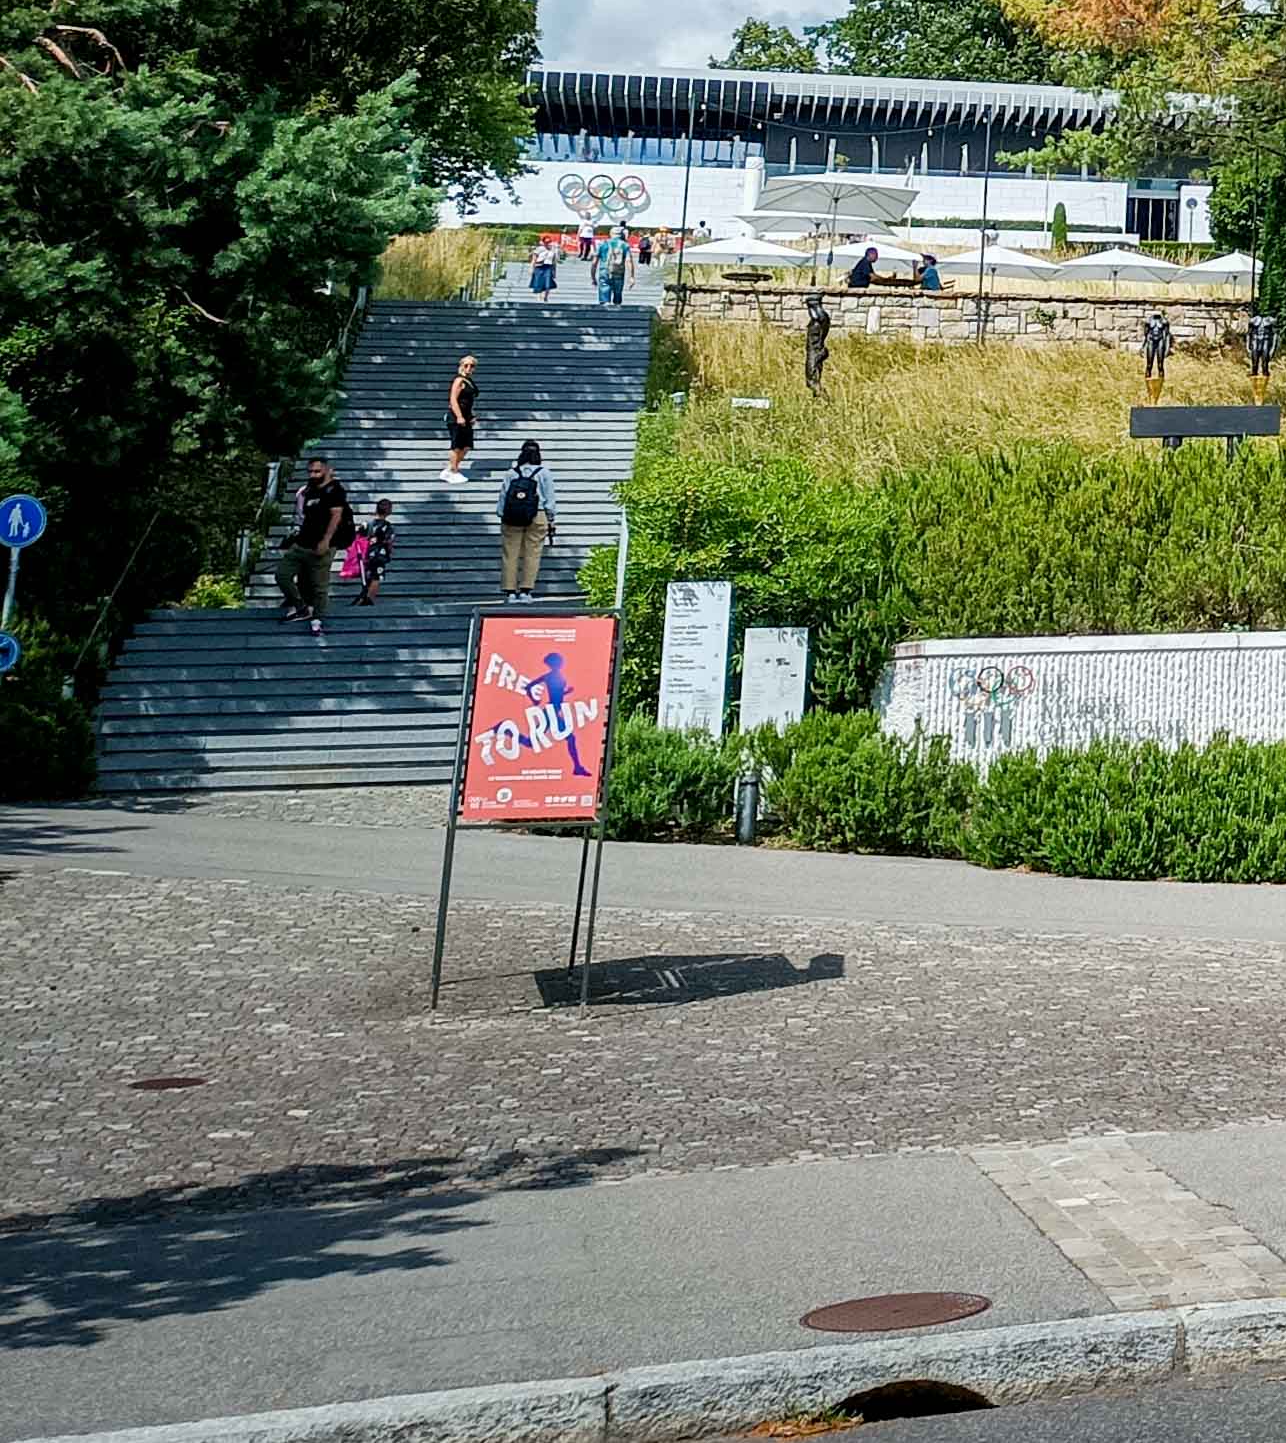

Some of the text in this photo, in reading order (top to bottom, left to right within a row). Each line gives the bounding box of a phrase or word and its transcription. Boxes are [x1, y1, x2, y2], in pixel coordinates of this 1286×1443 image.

[483, 652, 546, 701] FREE
[474, 698, 598, 766] TO RUN
